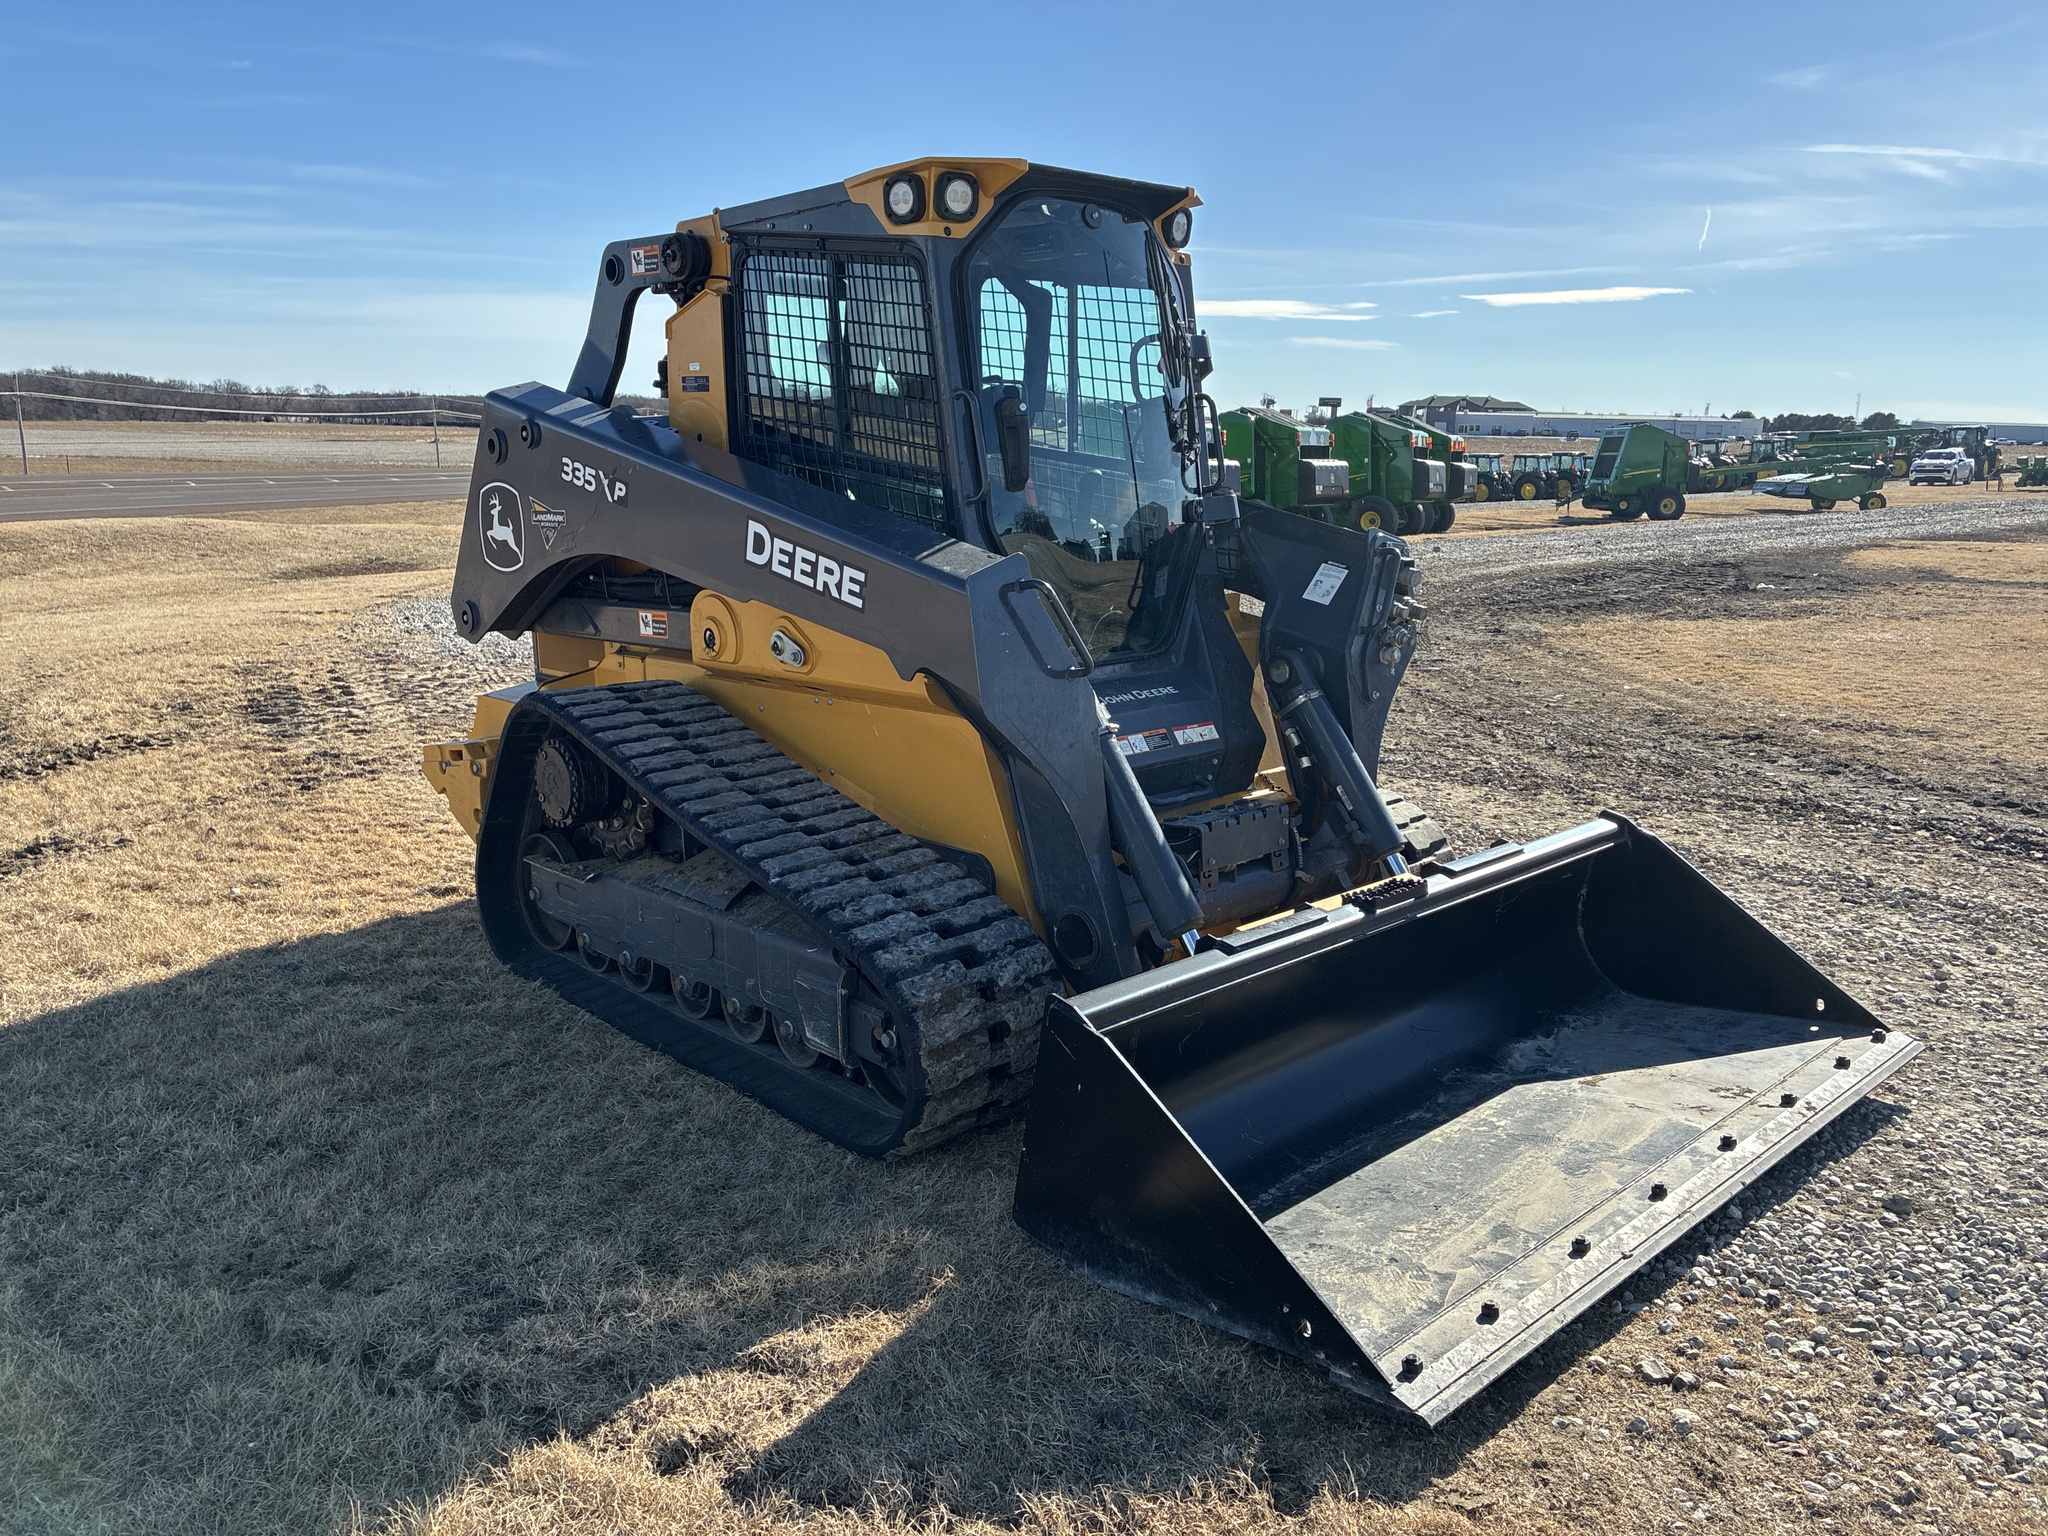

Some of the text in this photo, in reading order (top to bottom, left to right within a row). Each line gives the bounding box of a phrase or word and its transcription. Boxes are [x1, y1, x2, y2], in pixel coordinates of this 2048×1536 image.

[745, 519, 866, 609] DEERE
[1099, 686, 1179, 705] JOHN DEERE
